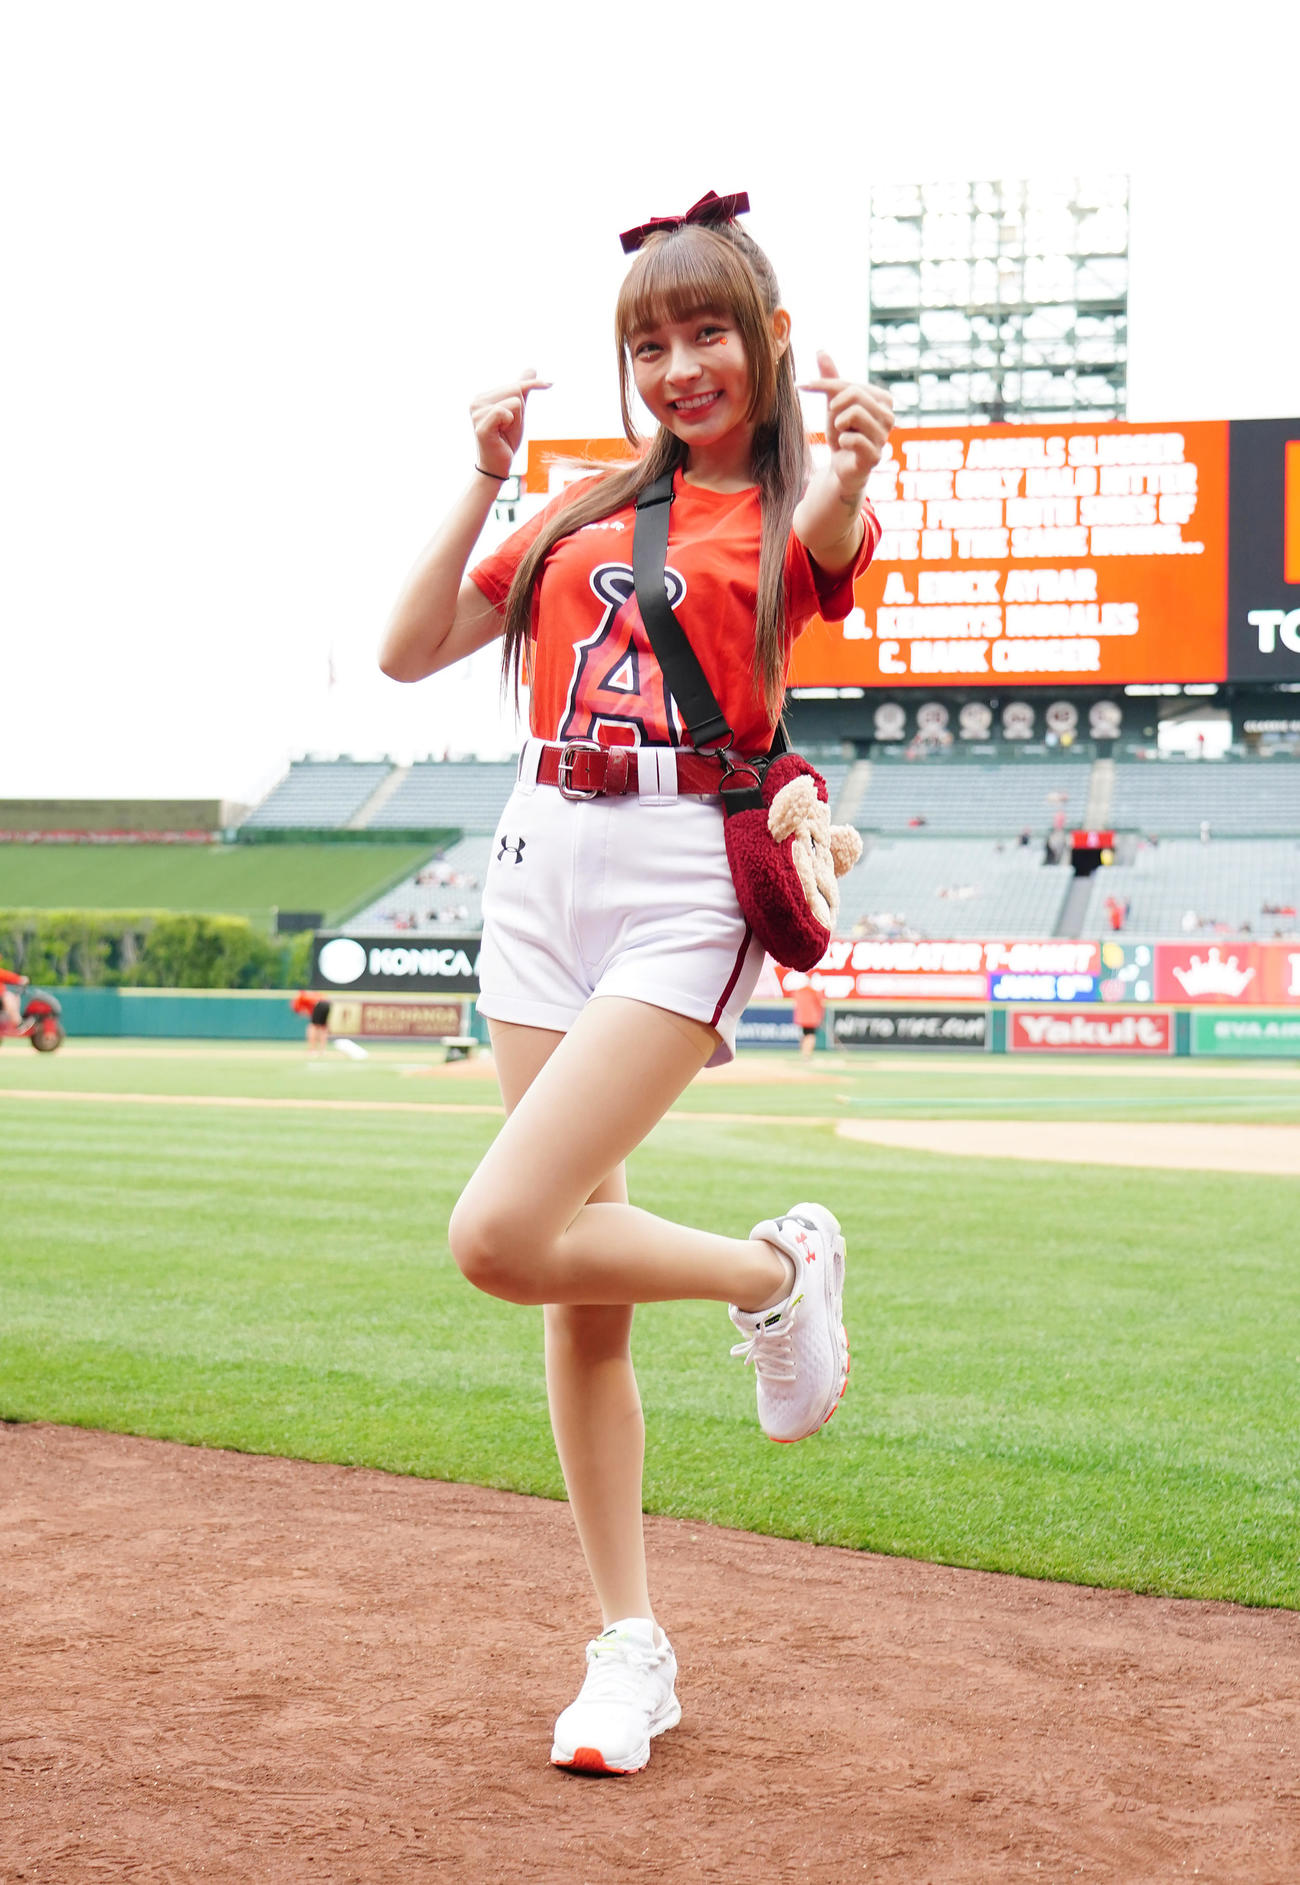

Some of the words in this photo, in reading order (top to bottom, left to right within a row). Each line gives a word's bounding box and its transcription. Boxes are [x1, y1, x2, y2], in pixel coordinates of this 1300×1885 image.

[1005, 603, 1138, 636] MORALES
[878, 641, 906, 674] C.
[368, 947, 474, 977] KONICA
[365, 1005, 460, 1023] PECHANGA
[1017, 1014, 1165, 1047] Yakult
